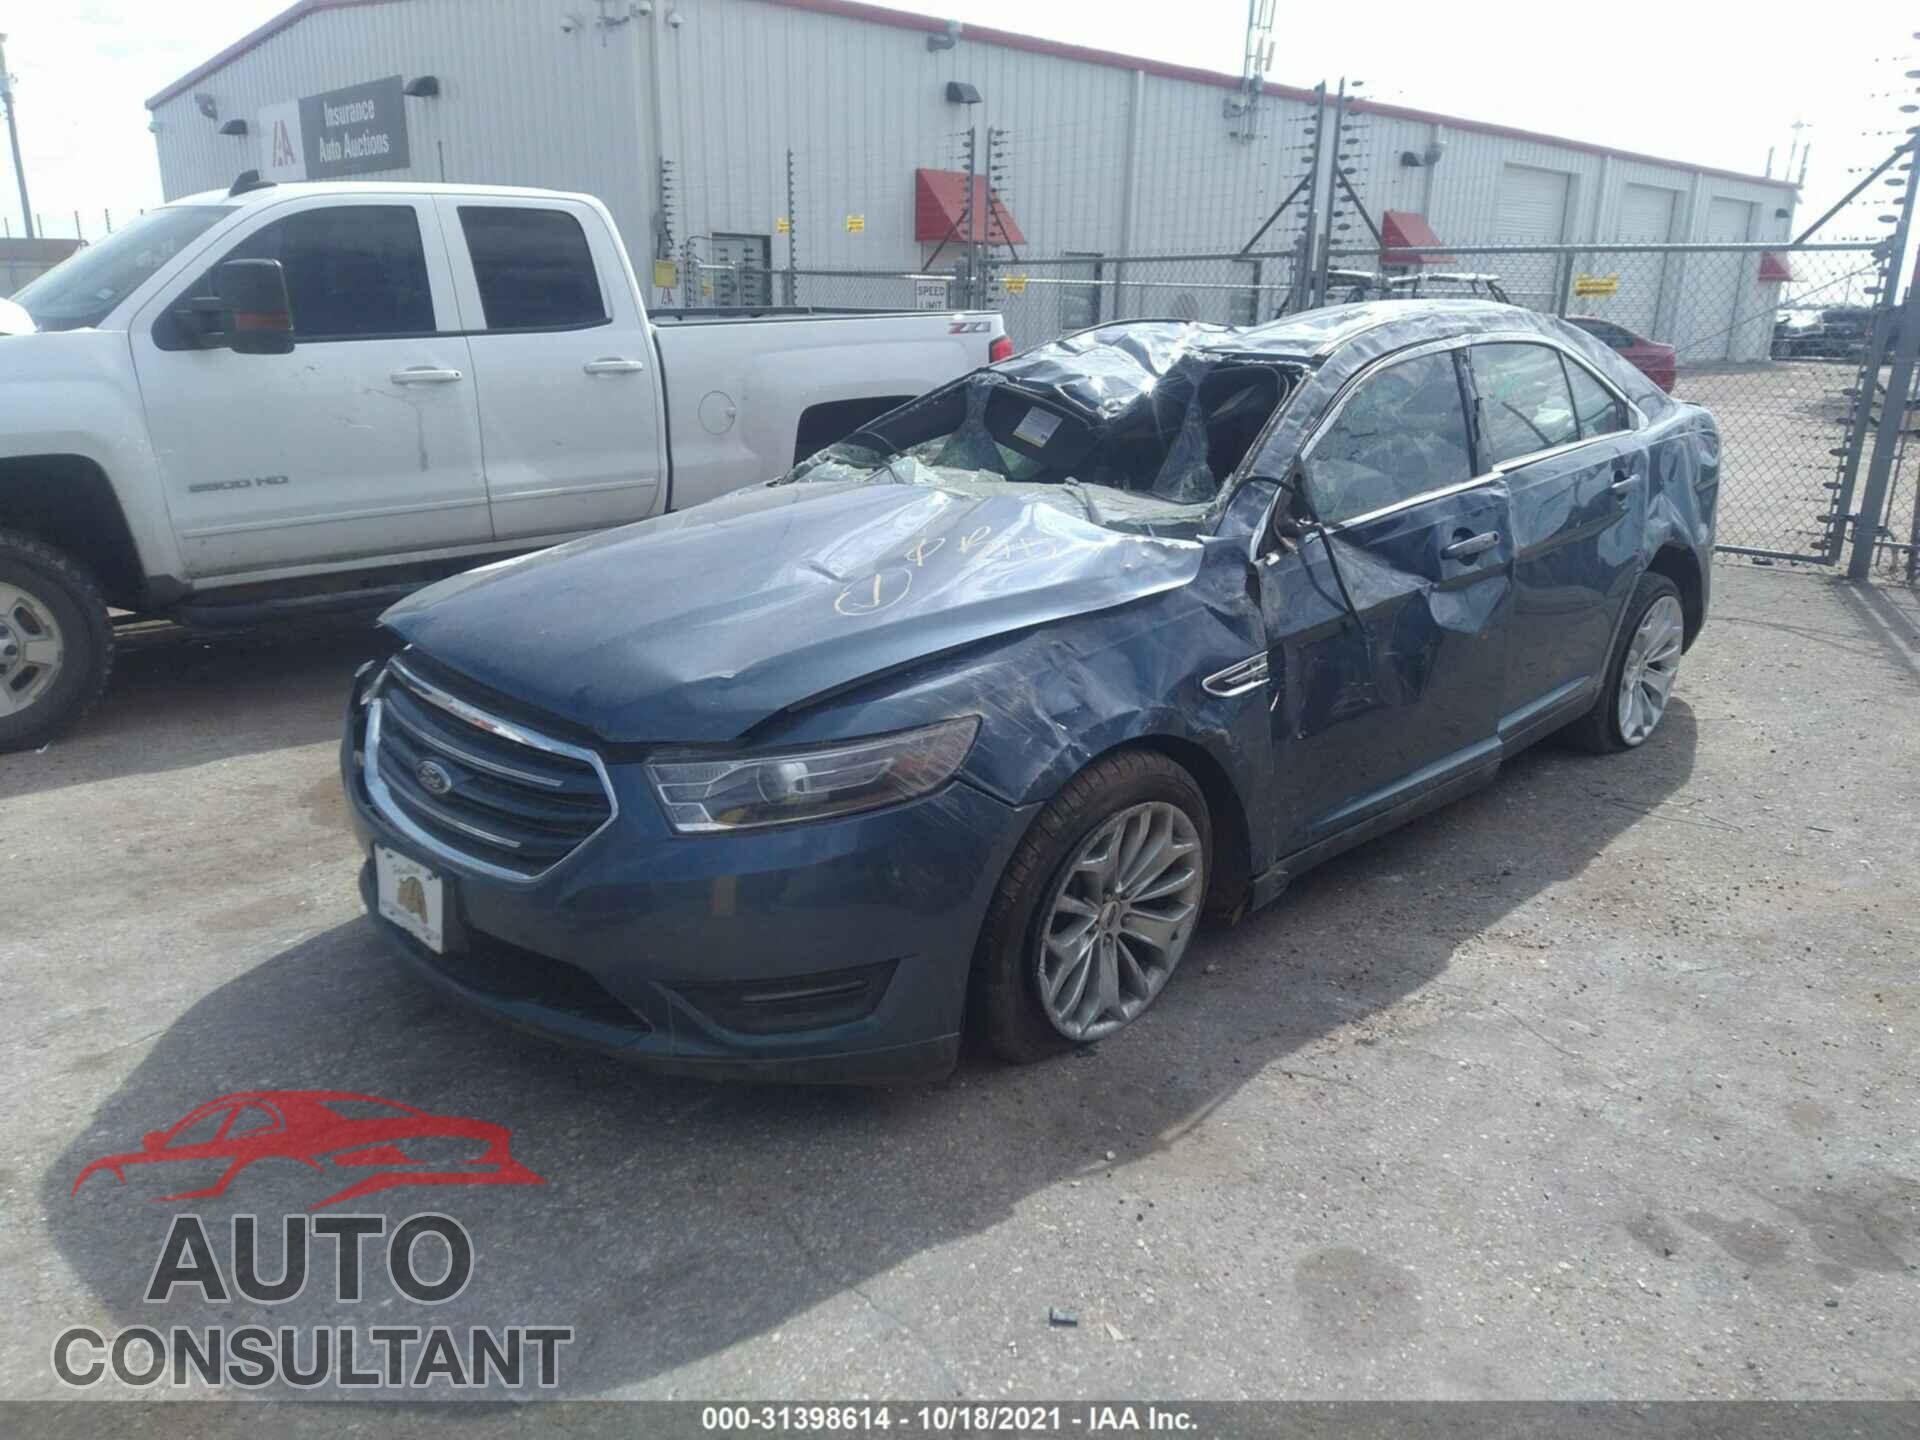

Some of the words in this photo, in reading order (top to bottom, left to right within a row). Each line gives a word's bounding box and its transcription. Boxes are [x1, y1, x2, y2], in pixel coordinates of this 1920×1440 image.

[323, 99, 376, 126] Insurance
[319, 137, 343, 162] Auto
[344, 129, 391, 157] Auctions
[917, 285, 945, 296] SPEED
